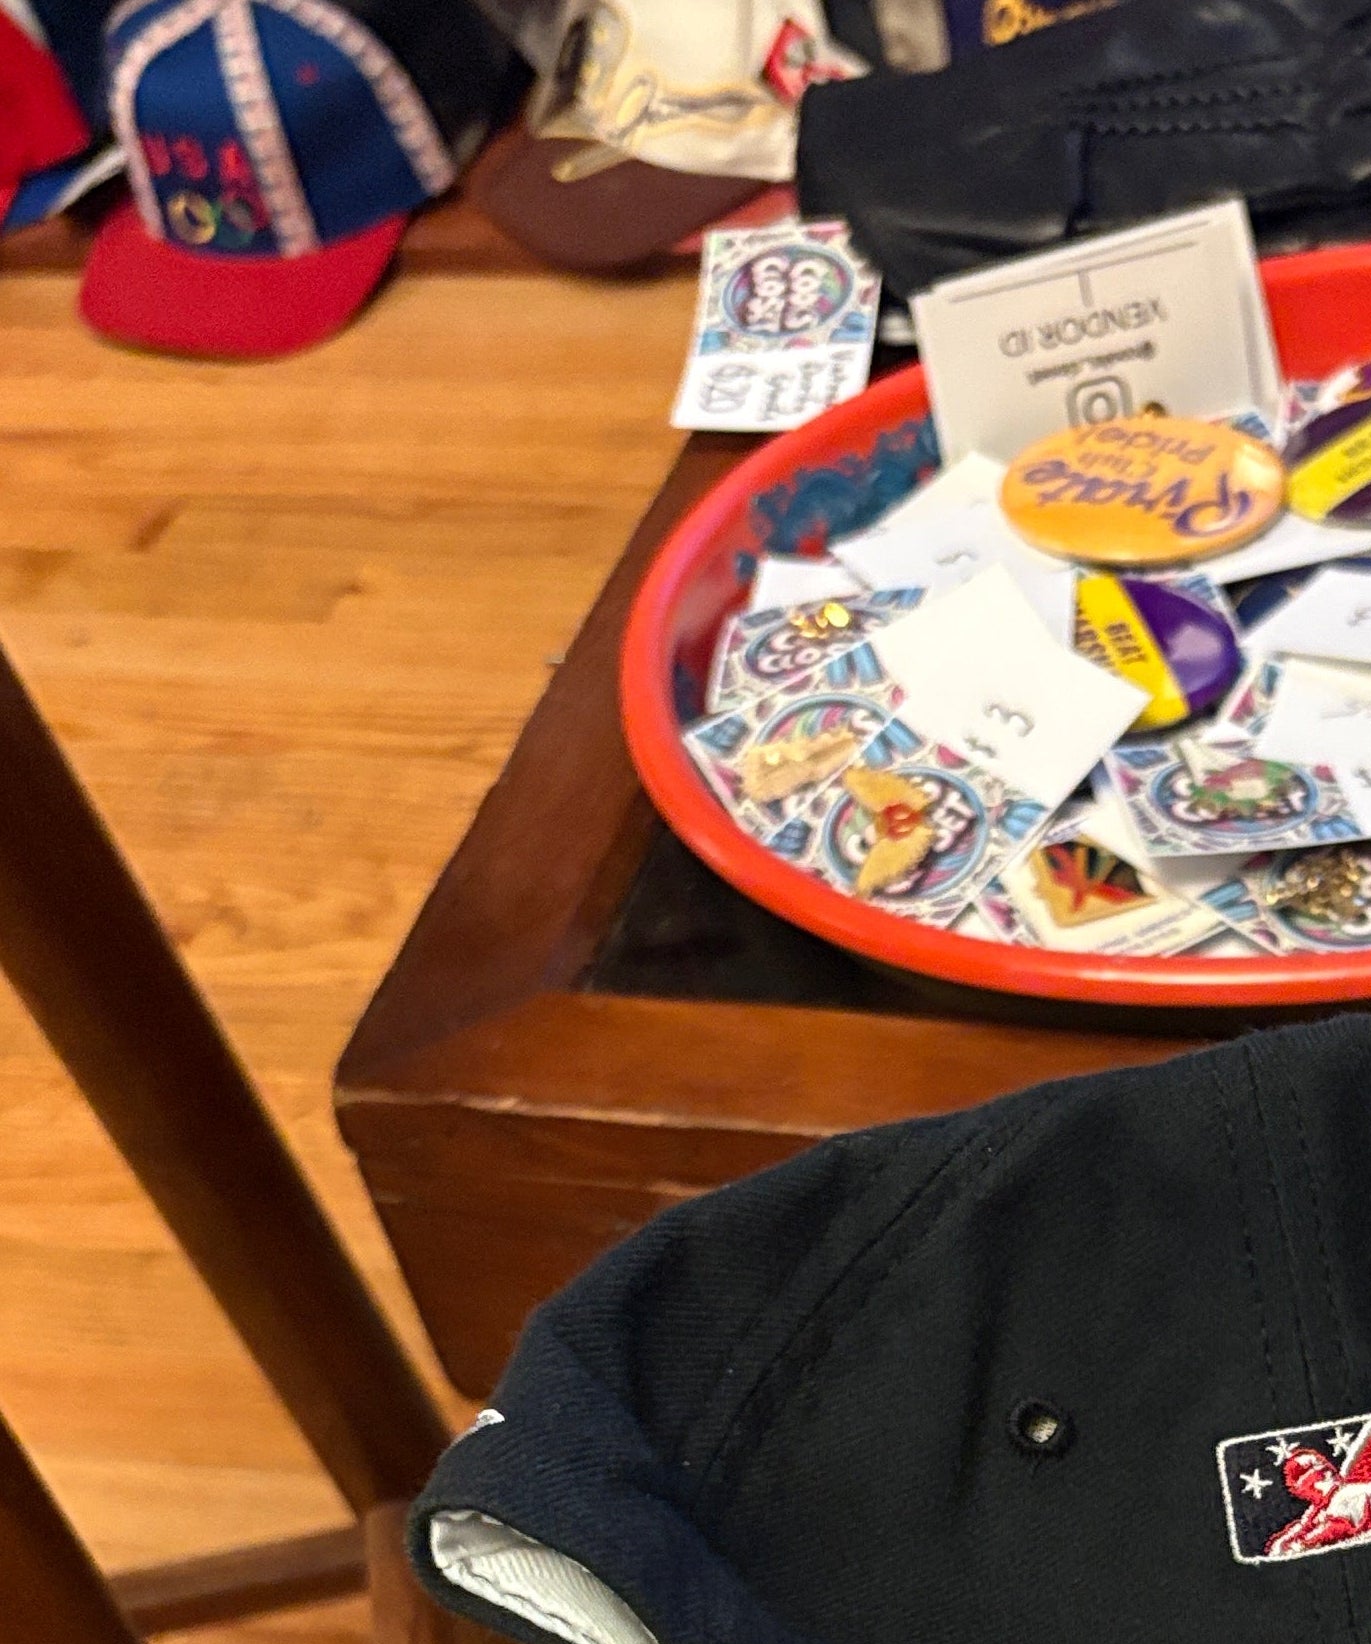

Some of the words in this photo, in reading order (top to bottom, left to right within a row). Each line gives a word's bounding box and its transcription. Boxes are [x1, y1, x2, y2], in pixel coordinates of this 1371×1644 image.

[998, 329, 1030, 358] ID
[1038, 299, 1168, 350] VENDOR
[1023, 460, 1251, 538] Pirate
[1105, 621, 1148, 665] BEAT
